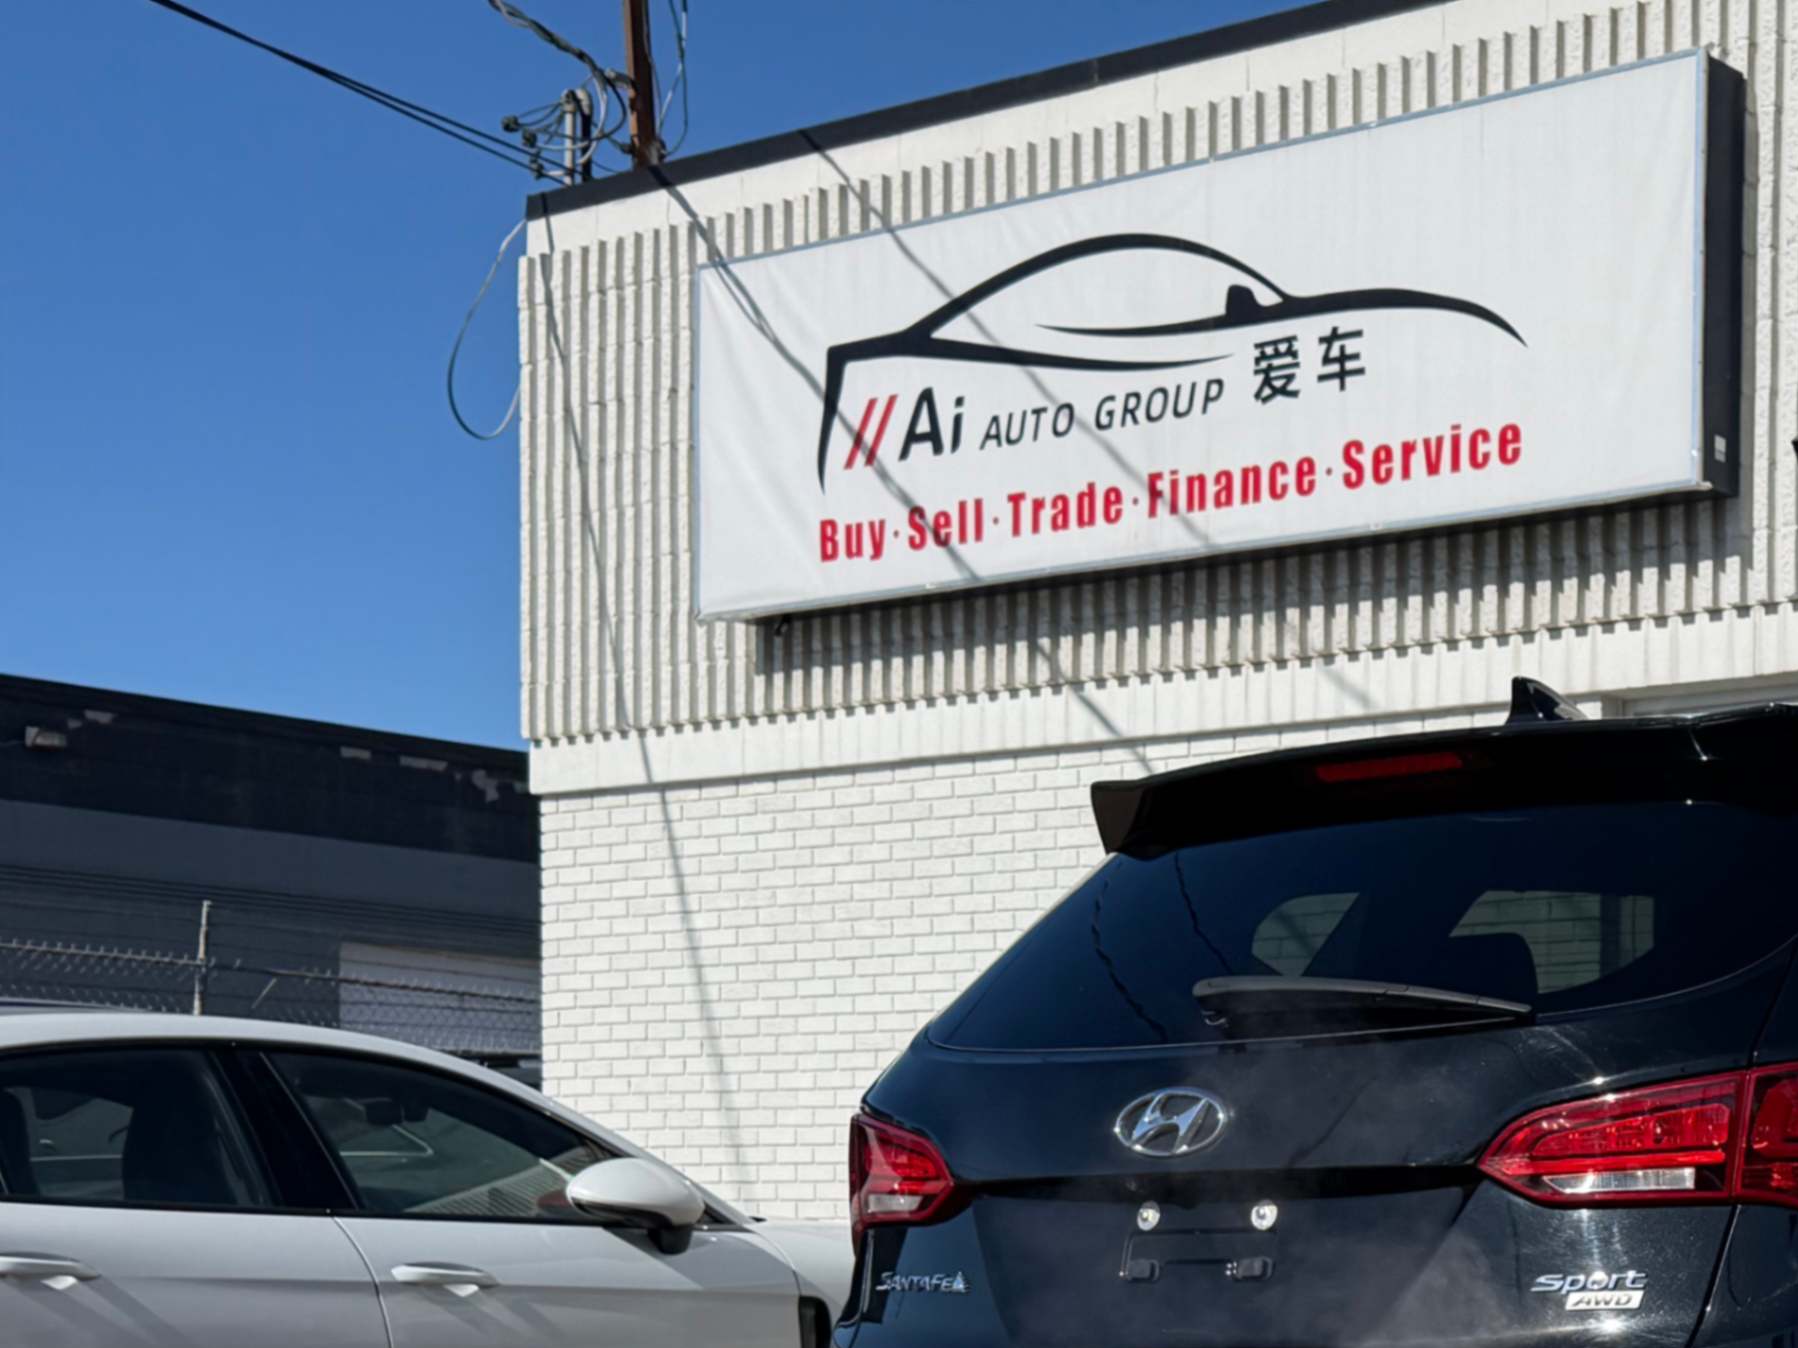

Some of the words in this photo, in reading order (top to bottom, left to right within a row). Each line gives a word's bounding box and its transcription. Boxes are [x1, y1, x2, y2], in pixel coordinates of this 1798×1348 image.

[1253, 326, 1366, 405] 爱车
[979, 402, 1076, 450] AUTO
[1094, 377, 1225, 431] GROUP
[819, 518, 886, 562] Buy
[907, 499, 984, 551] Sell
[1007, 482, 1124, 537] Trade
[1147, 456, 1317, 518] Finance
[1342, 423, 1522, 491] Service
[1530, 1270, 1648, 1294] Sport
[1572, 1294, 1634, 1308] AWD
